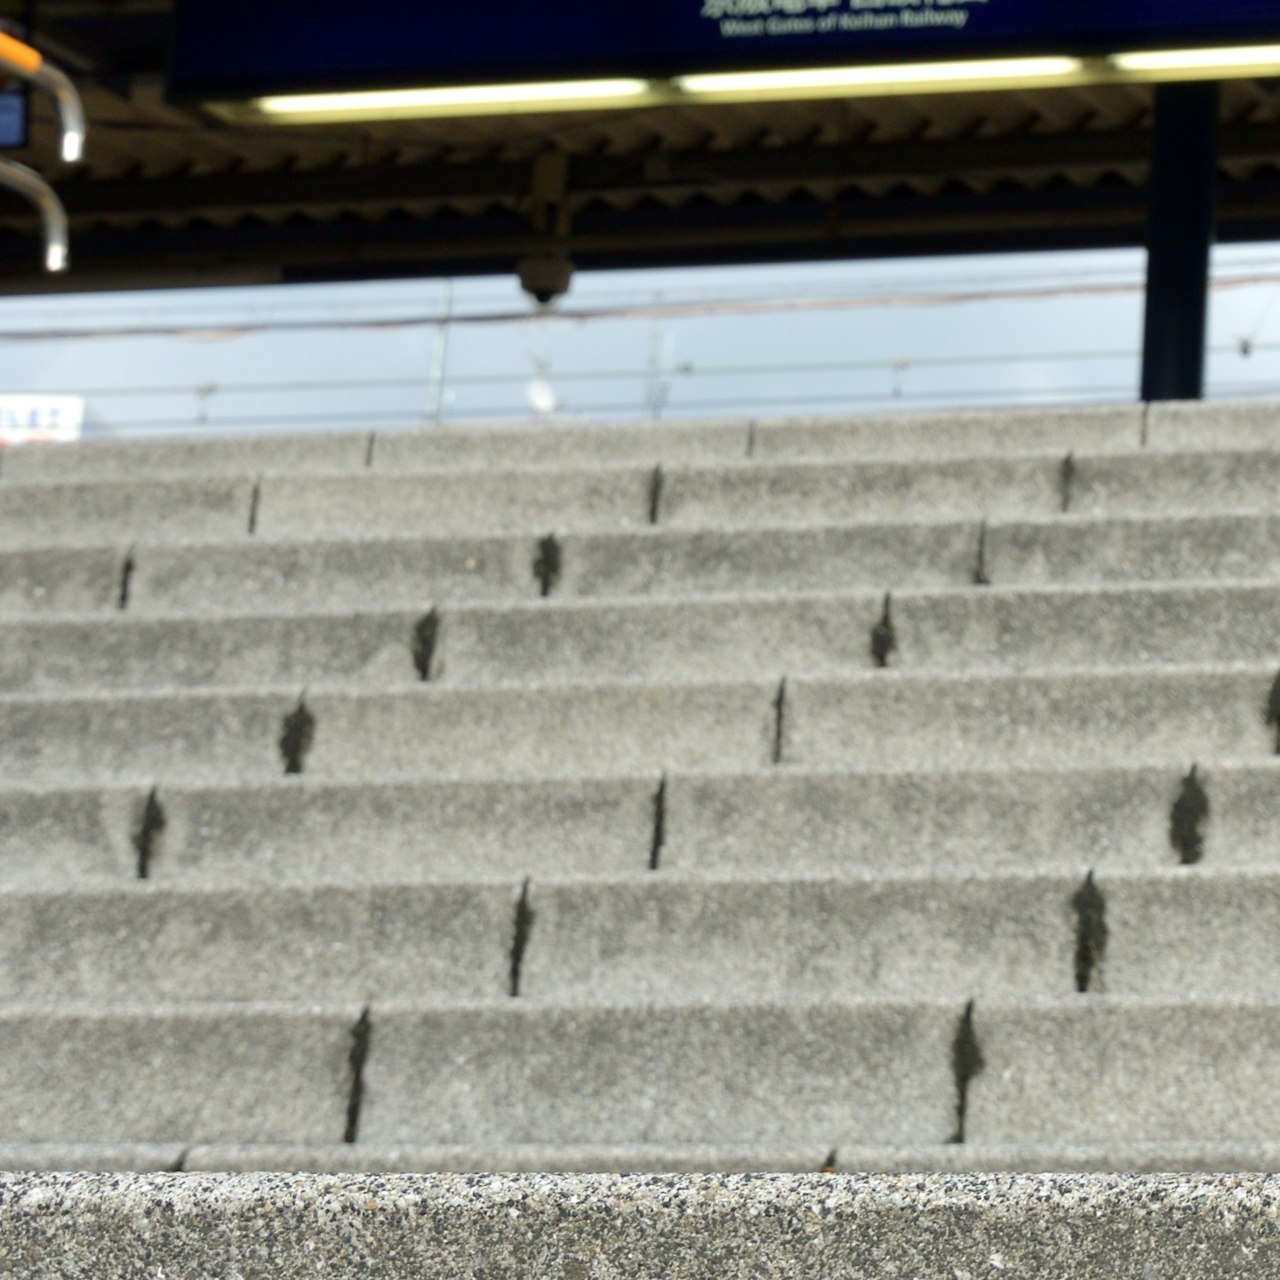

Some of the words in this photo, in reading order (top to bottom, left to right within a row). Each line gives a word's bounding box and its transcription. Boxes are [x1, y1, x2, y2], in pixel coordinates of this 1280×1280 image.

[720, 18, 765, 37] West
[816, 13, 838, 32] of
[900, 6, 969, 29] Railway
